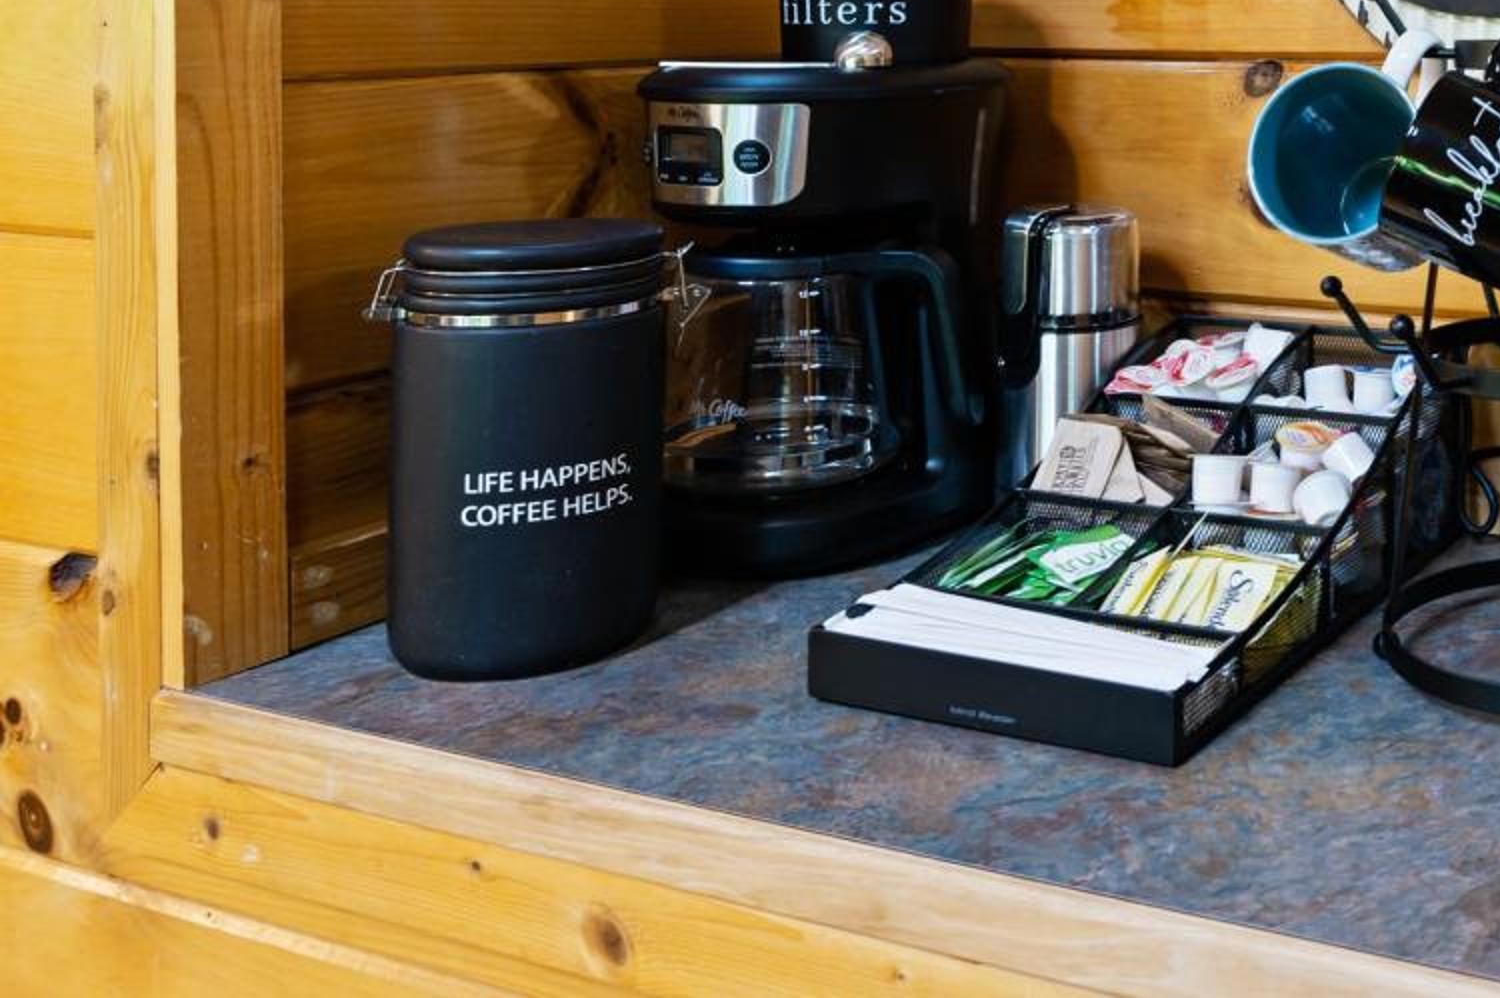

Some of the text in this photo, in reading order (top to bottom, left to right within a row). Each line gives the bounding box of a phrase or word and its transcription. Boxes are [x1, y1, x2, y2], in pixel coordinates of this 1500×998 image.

[463, 453, 632, 495] LIFE HAPPENS,
[460, 483, 633, 527] COFFEE HELPS.
[1209, 569, 1255, 628] Splend
